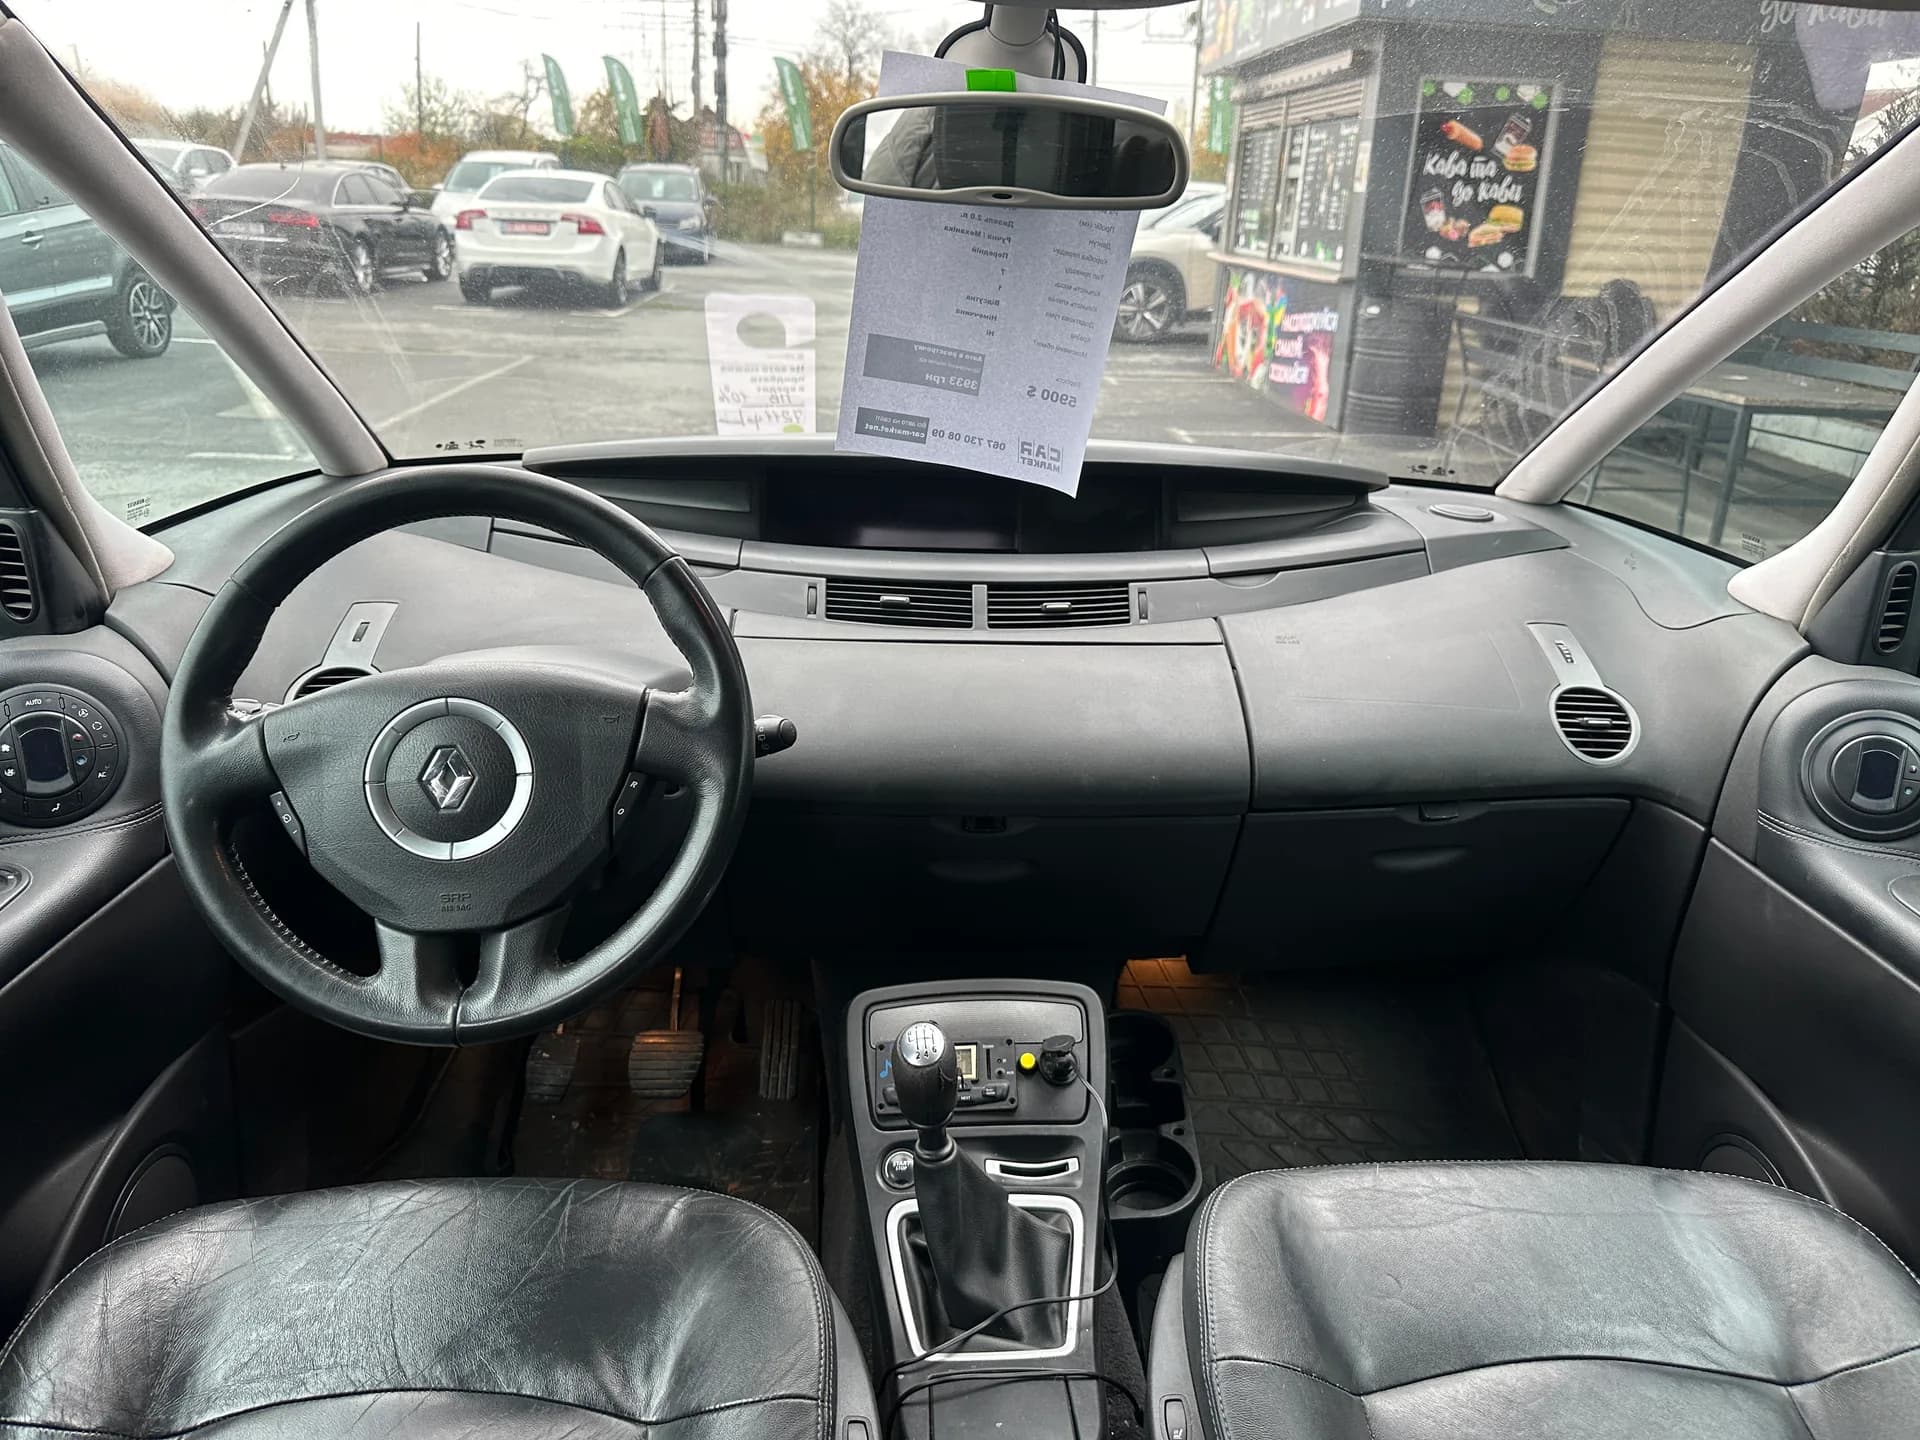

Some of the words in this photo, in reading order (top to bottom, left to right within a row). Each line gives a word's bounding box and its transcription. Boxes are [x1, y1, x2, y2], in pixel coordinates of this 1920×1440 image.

[25, 698, 42, 707] AUTO
[630, 780, 639, 789] R
[915, 1051, 921, 1060] 2
[924, 1050, 929, 1058] 4
[931, 1046, 938, 1054] 6
